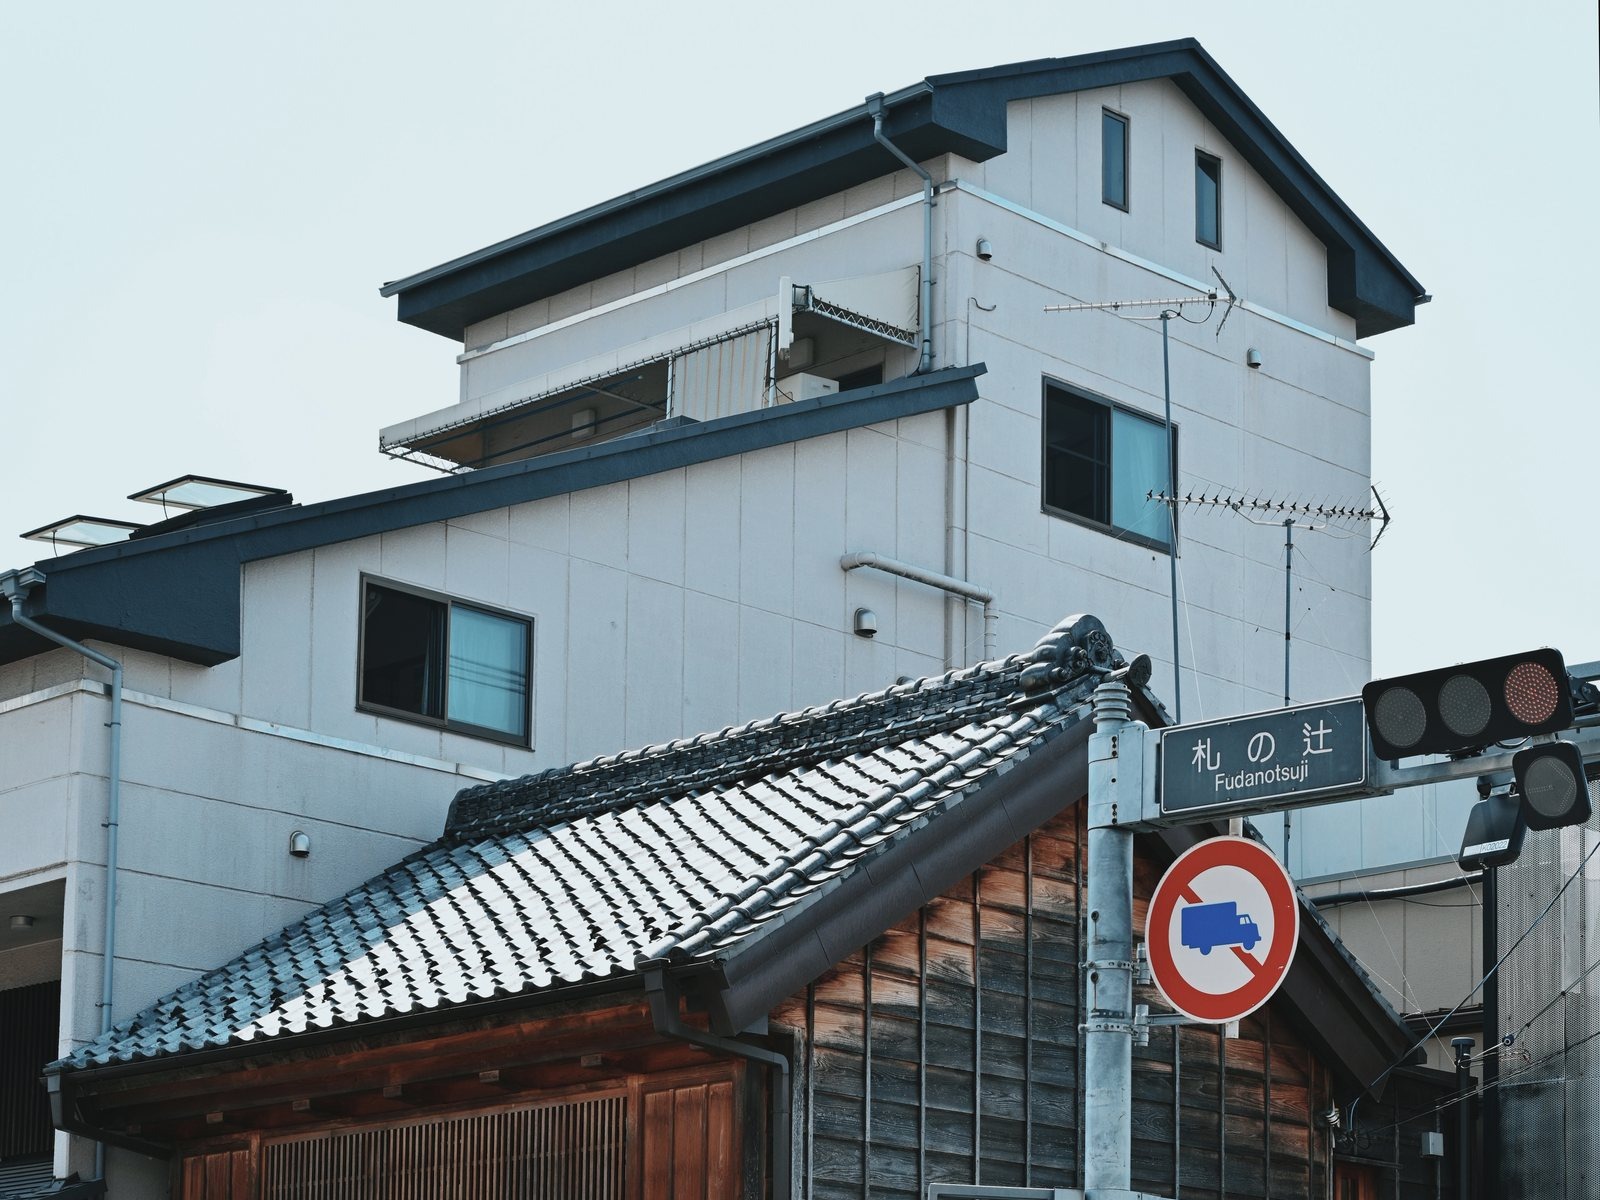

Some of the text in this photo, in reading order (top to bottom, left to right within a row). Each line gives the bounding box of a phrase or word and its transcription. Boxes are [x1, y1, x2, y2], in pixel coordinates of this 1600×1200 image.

[1191, 719, 1334, 773] 札の辻
[1215, 759, 1309, 792] Fudanotsuji
